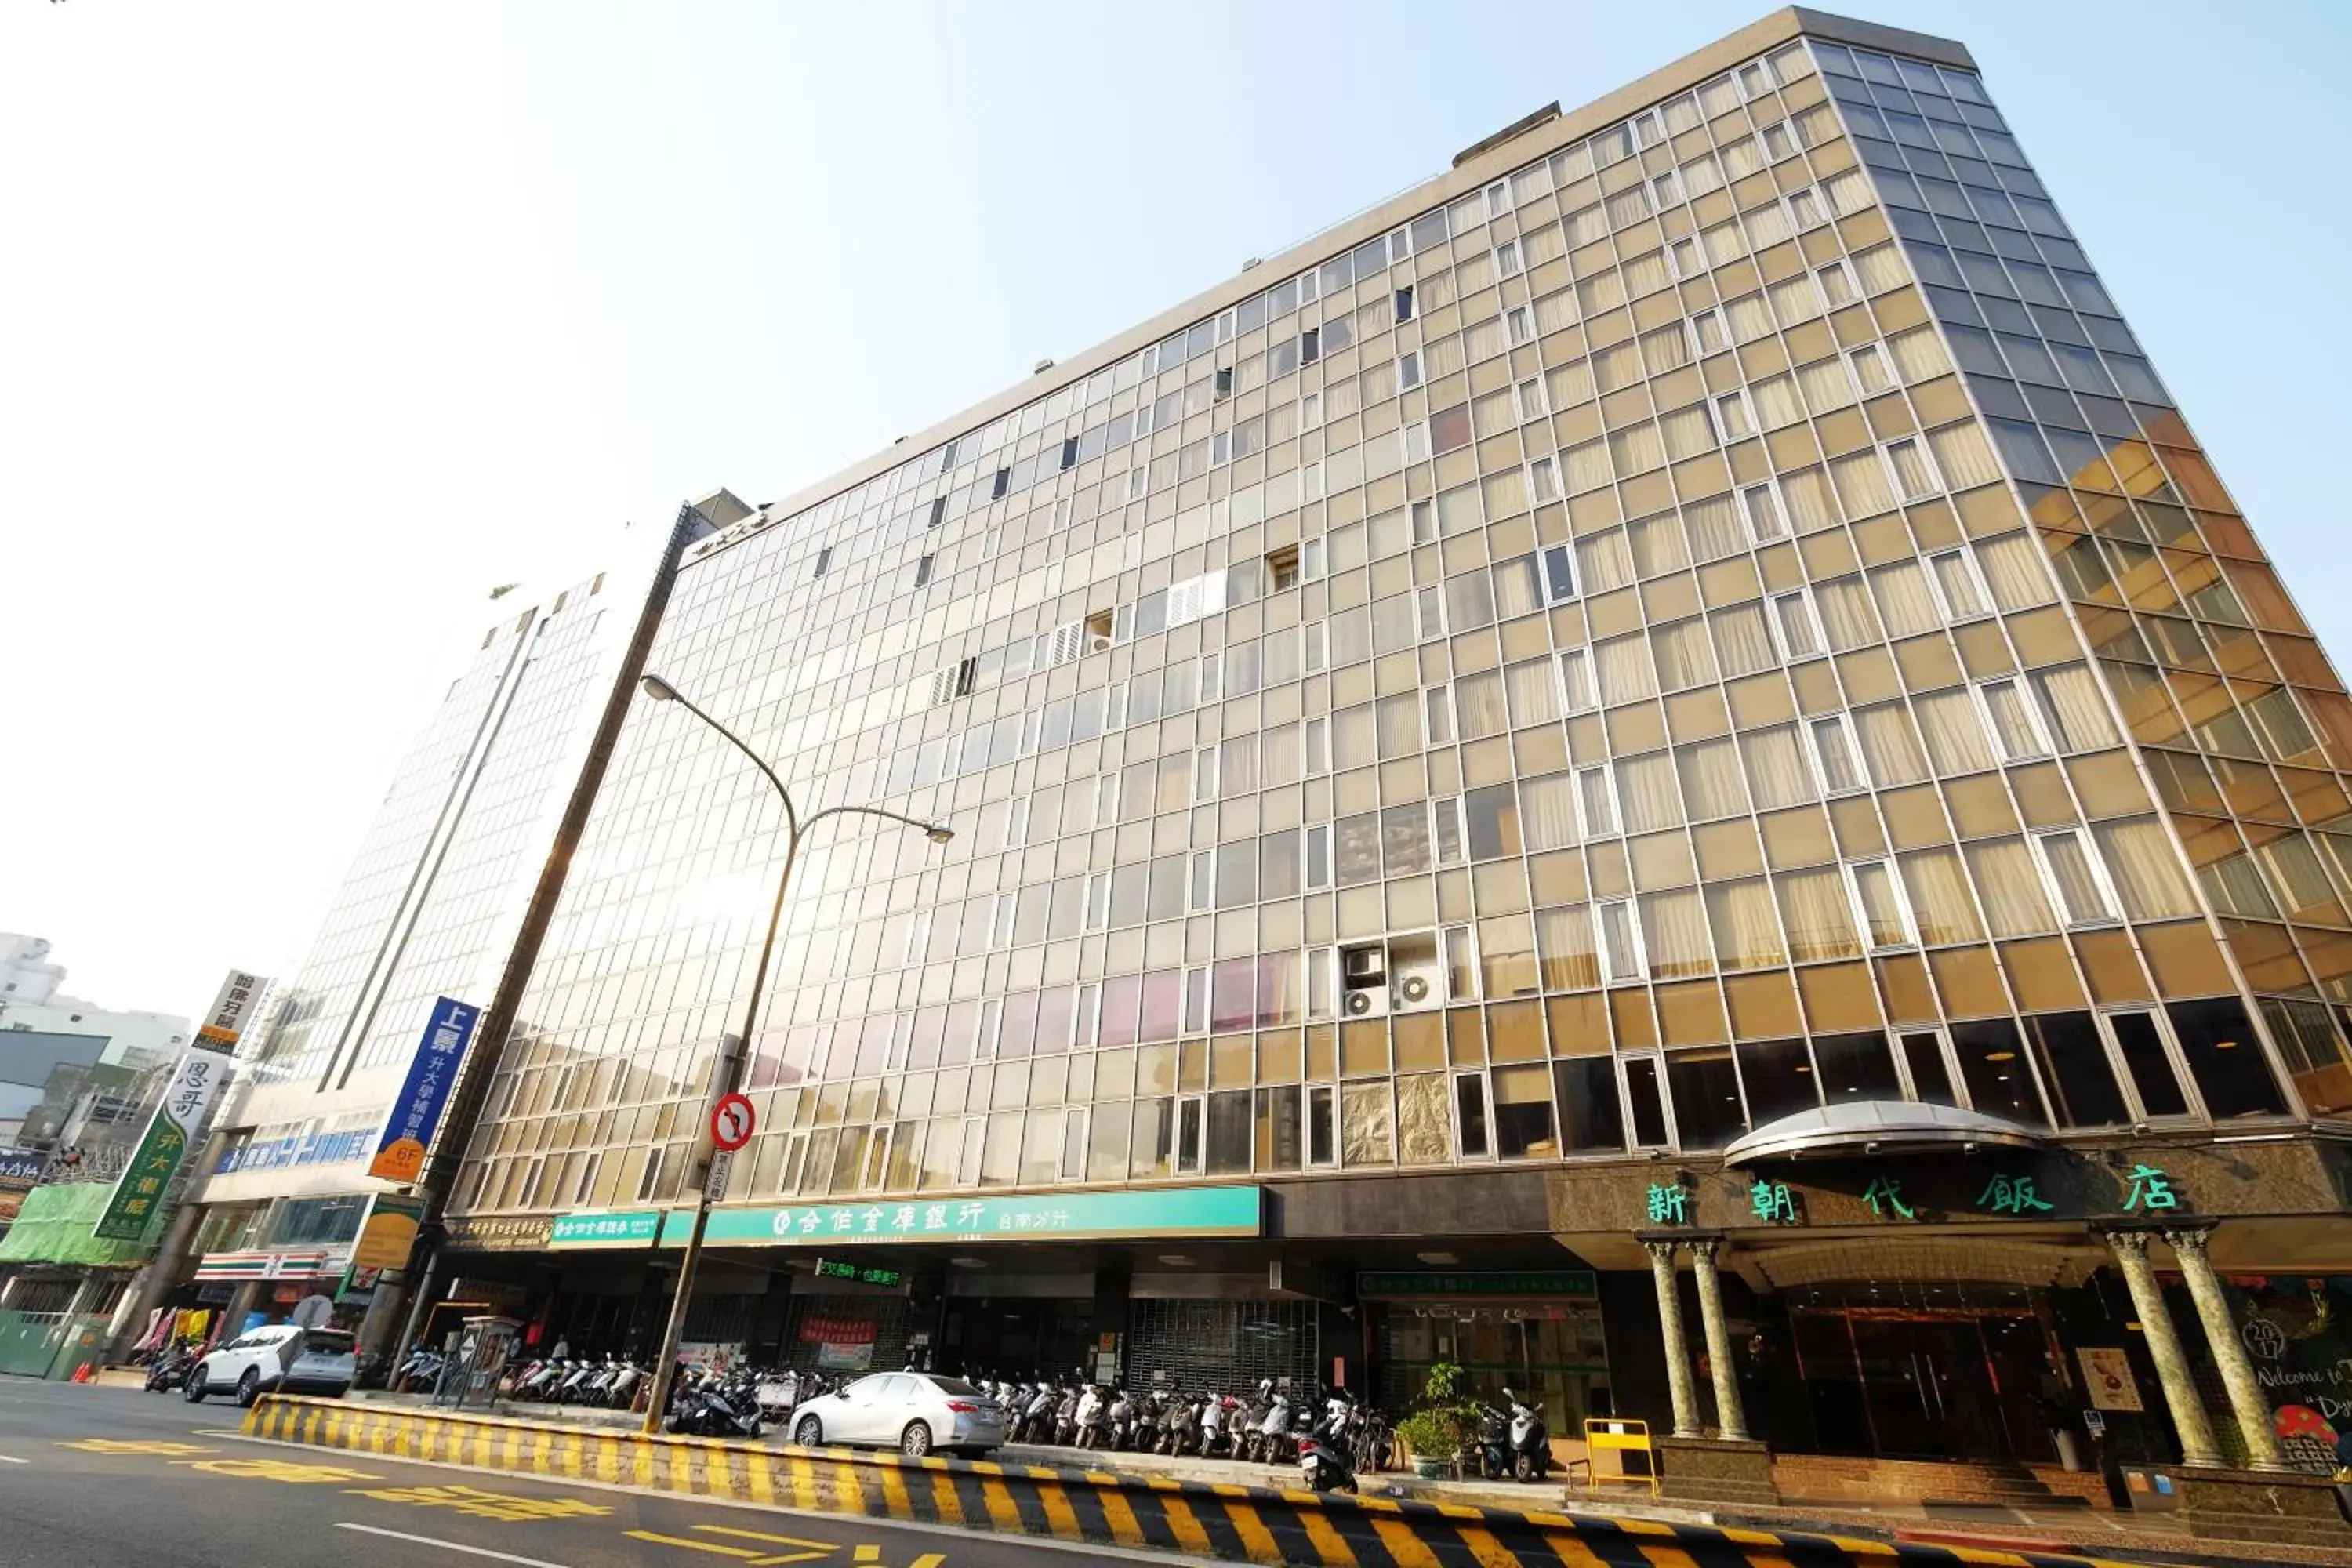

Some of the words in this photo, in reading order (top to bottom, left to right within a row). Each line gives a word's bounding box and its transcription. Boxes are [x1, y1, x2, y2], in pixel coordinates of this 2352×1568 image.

[395, 1147, 419, 1162] 6F
[1646, 1163, 2176, 1224] 新朝代飯店
[798, 1202, 985, 1234] 合作金庫銀行
